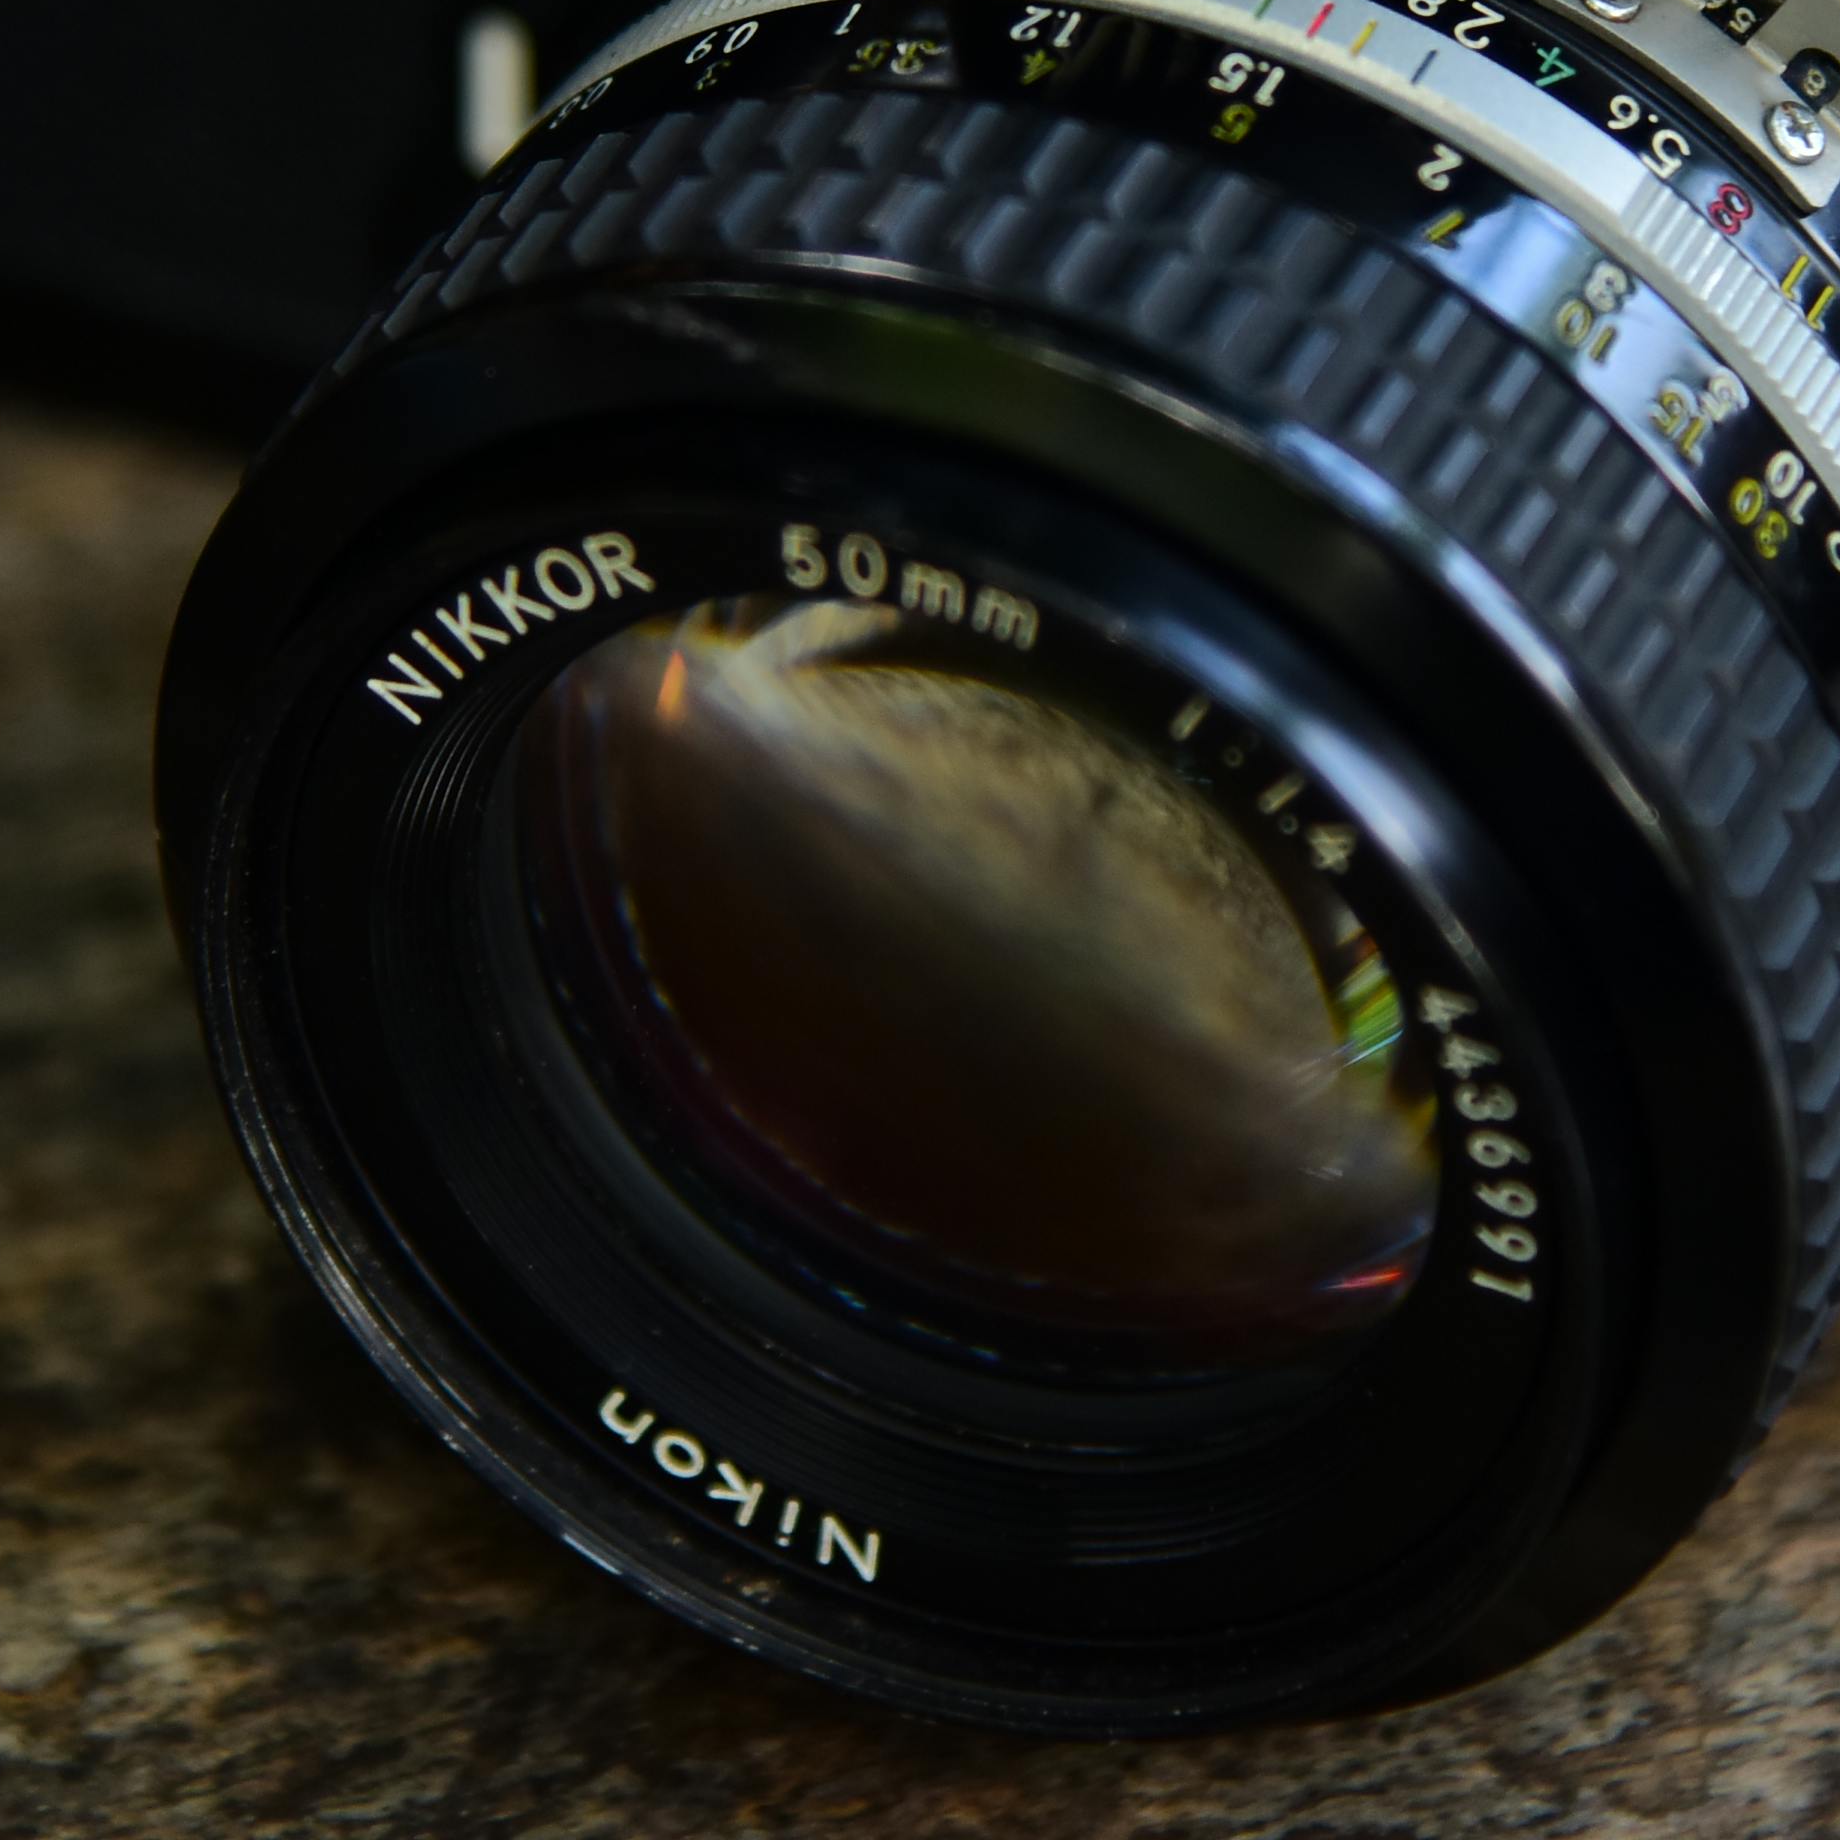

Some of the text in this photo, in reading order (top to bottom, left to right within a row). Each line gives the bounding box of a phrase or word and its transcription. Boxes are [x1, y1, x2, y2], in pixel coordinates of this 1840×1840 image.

[684, 20, 760, 65] 0.9
[833, 1, 864, 35] 1
[1009, 4, 1082, 48] 1.2
[1207, 51, 1287, 107] 1.5
[1534, 46, 1576, 88] 4
[1802, 68, 1827, 98] 8
[1210, 103, 1256, 143] 5
[1607, 93, 1691, 179] 5.6
[1417, 144, 1466, 191] 2
[1709, 182, 1754, 235] 8
[1780, 254, 1837, 332] 11
[1765, 449, 1817, 525] 10
[366, 530, 658, 726] NIKKOR
[780, 522, 1040, 651] 50mm
[1418, 982, 1540, 1304] 4436991
[597, 1385, 882, 1583] Nikon
